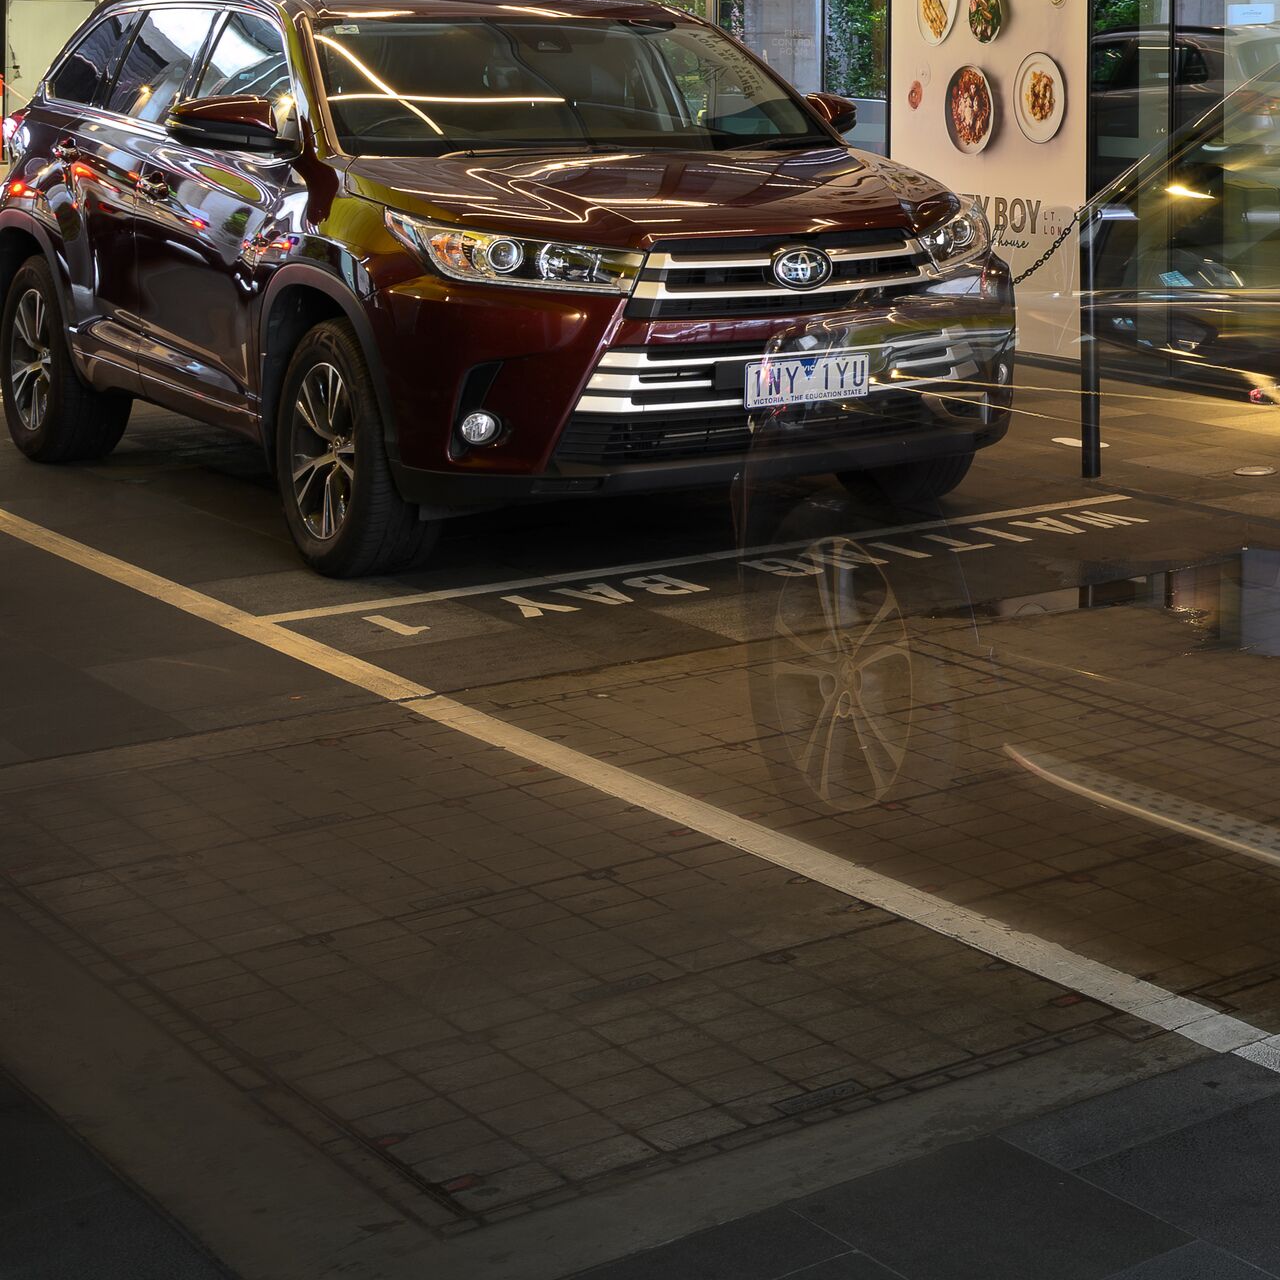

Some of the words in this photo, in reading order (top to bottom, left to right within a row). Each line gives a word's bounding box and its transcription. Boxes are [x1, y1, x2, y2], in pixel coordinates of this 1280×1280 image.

[771, 38, 815, 49] CONTROL
[994, 197, 1042, 234] BOY
[823, 360, 866, 391] 1YU
[753, 396, 784, 405] VICTORIA
[791, 394, 804, 402] THE
[805, 390, 842, 401] EDUCATION
[843, 388, 863, 397] STATE
[500, 573, 710, 620] BAY
